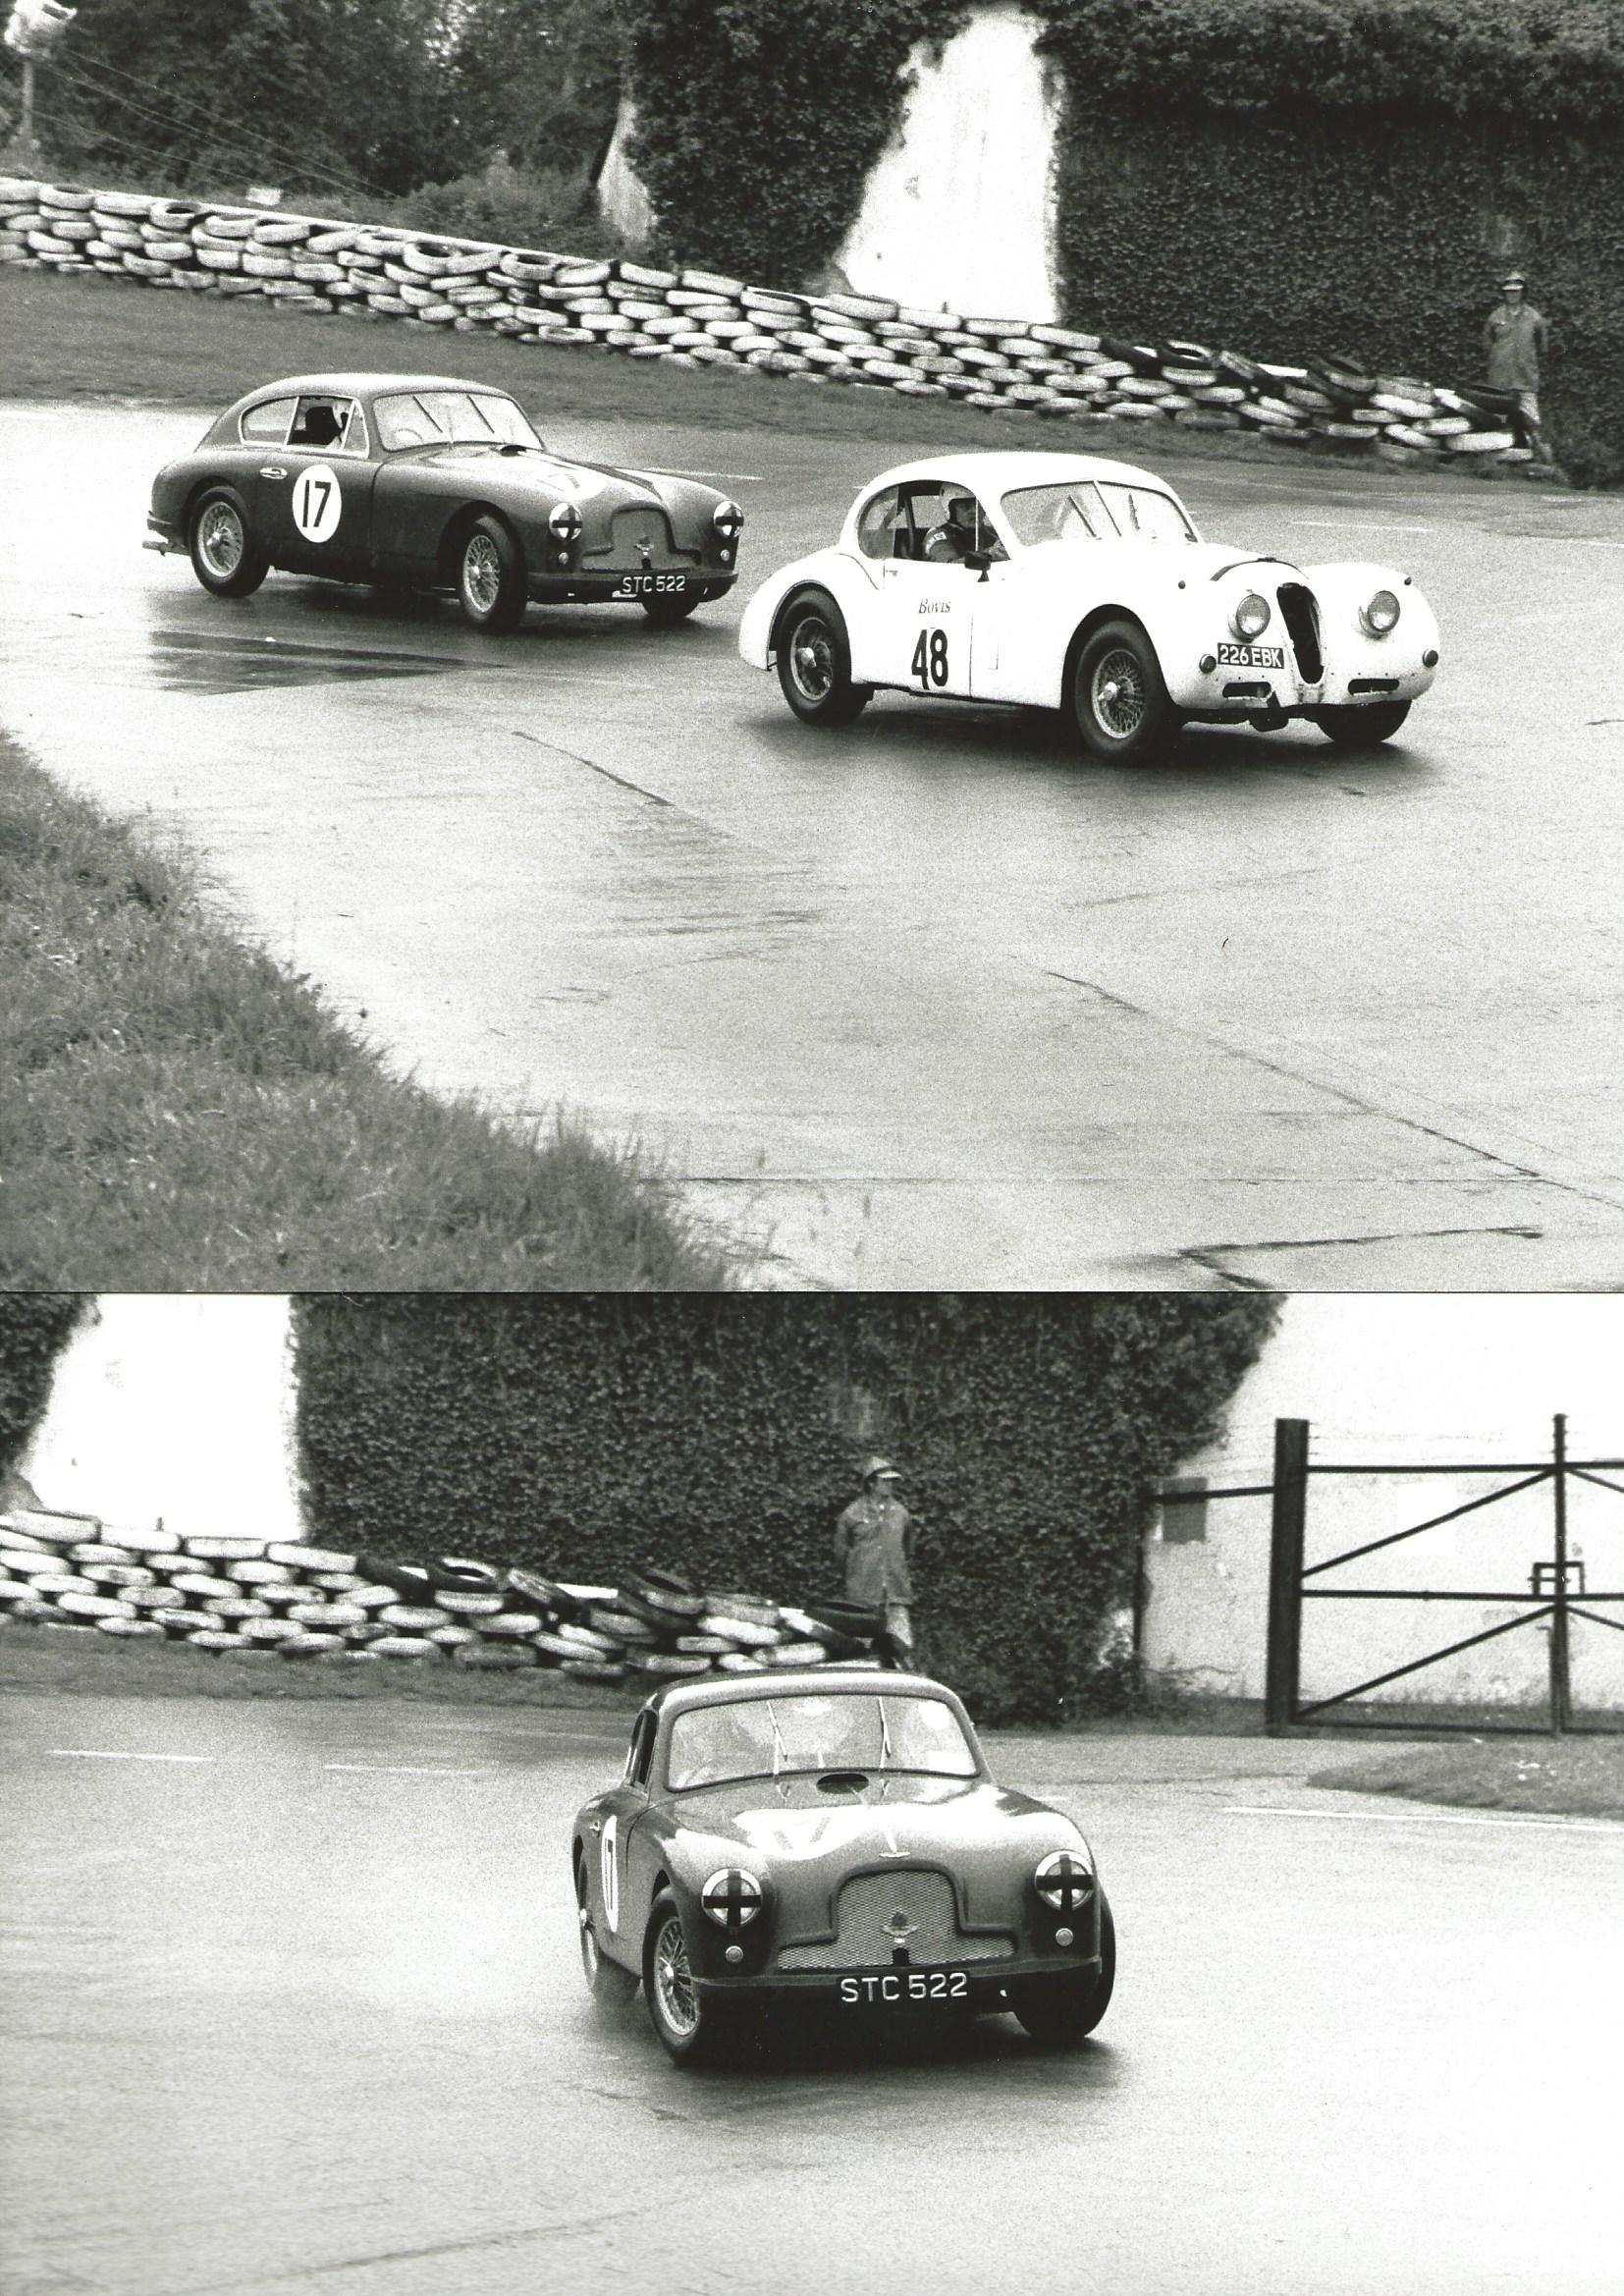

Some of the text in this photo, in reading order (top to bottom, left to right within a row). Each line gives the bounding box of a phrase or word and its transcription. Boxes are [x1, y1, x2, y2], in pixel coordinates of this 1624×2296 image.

[302, 479, 332, 528] 17
[622, 574, 686, 593] STC 522
[911, 629, 948, 690] 48
[1219, 644, 1282, 668] 226 EBK
[840, 1972, 967, 2002] STC 522
